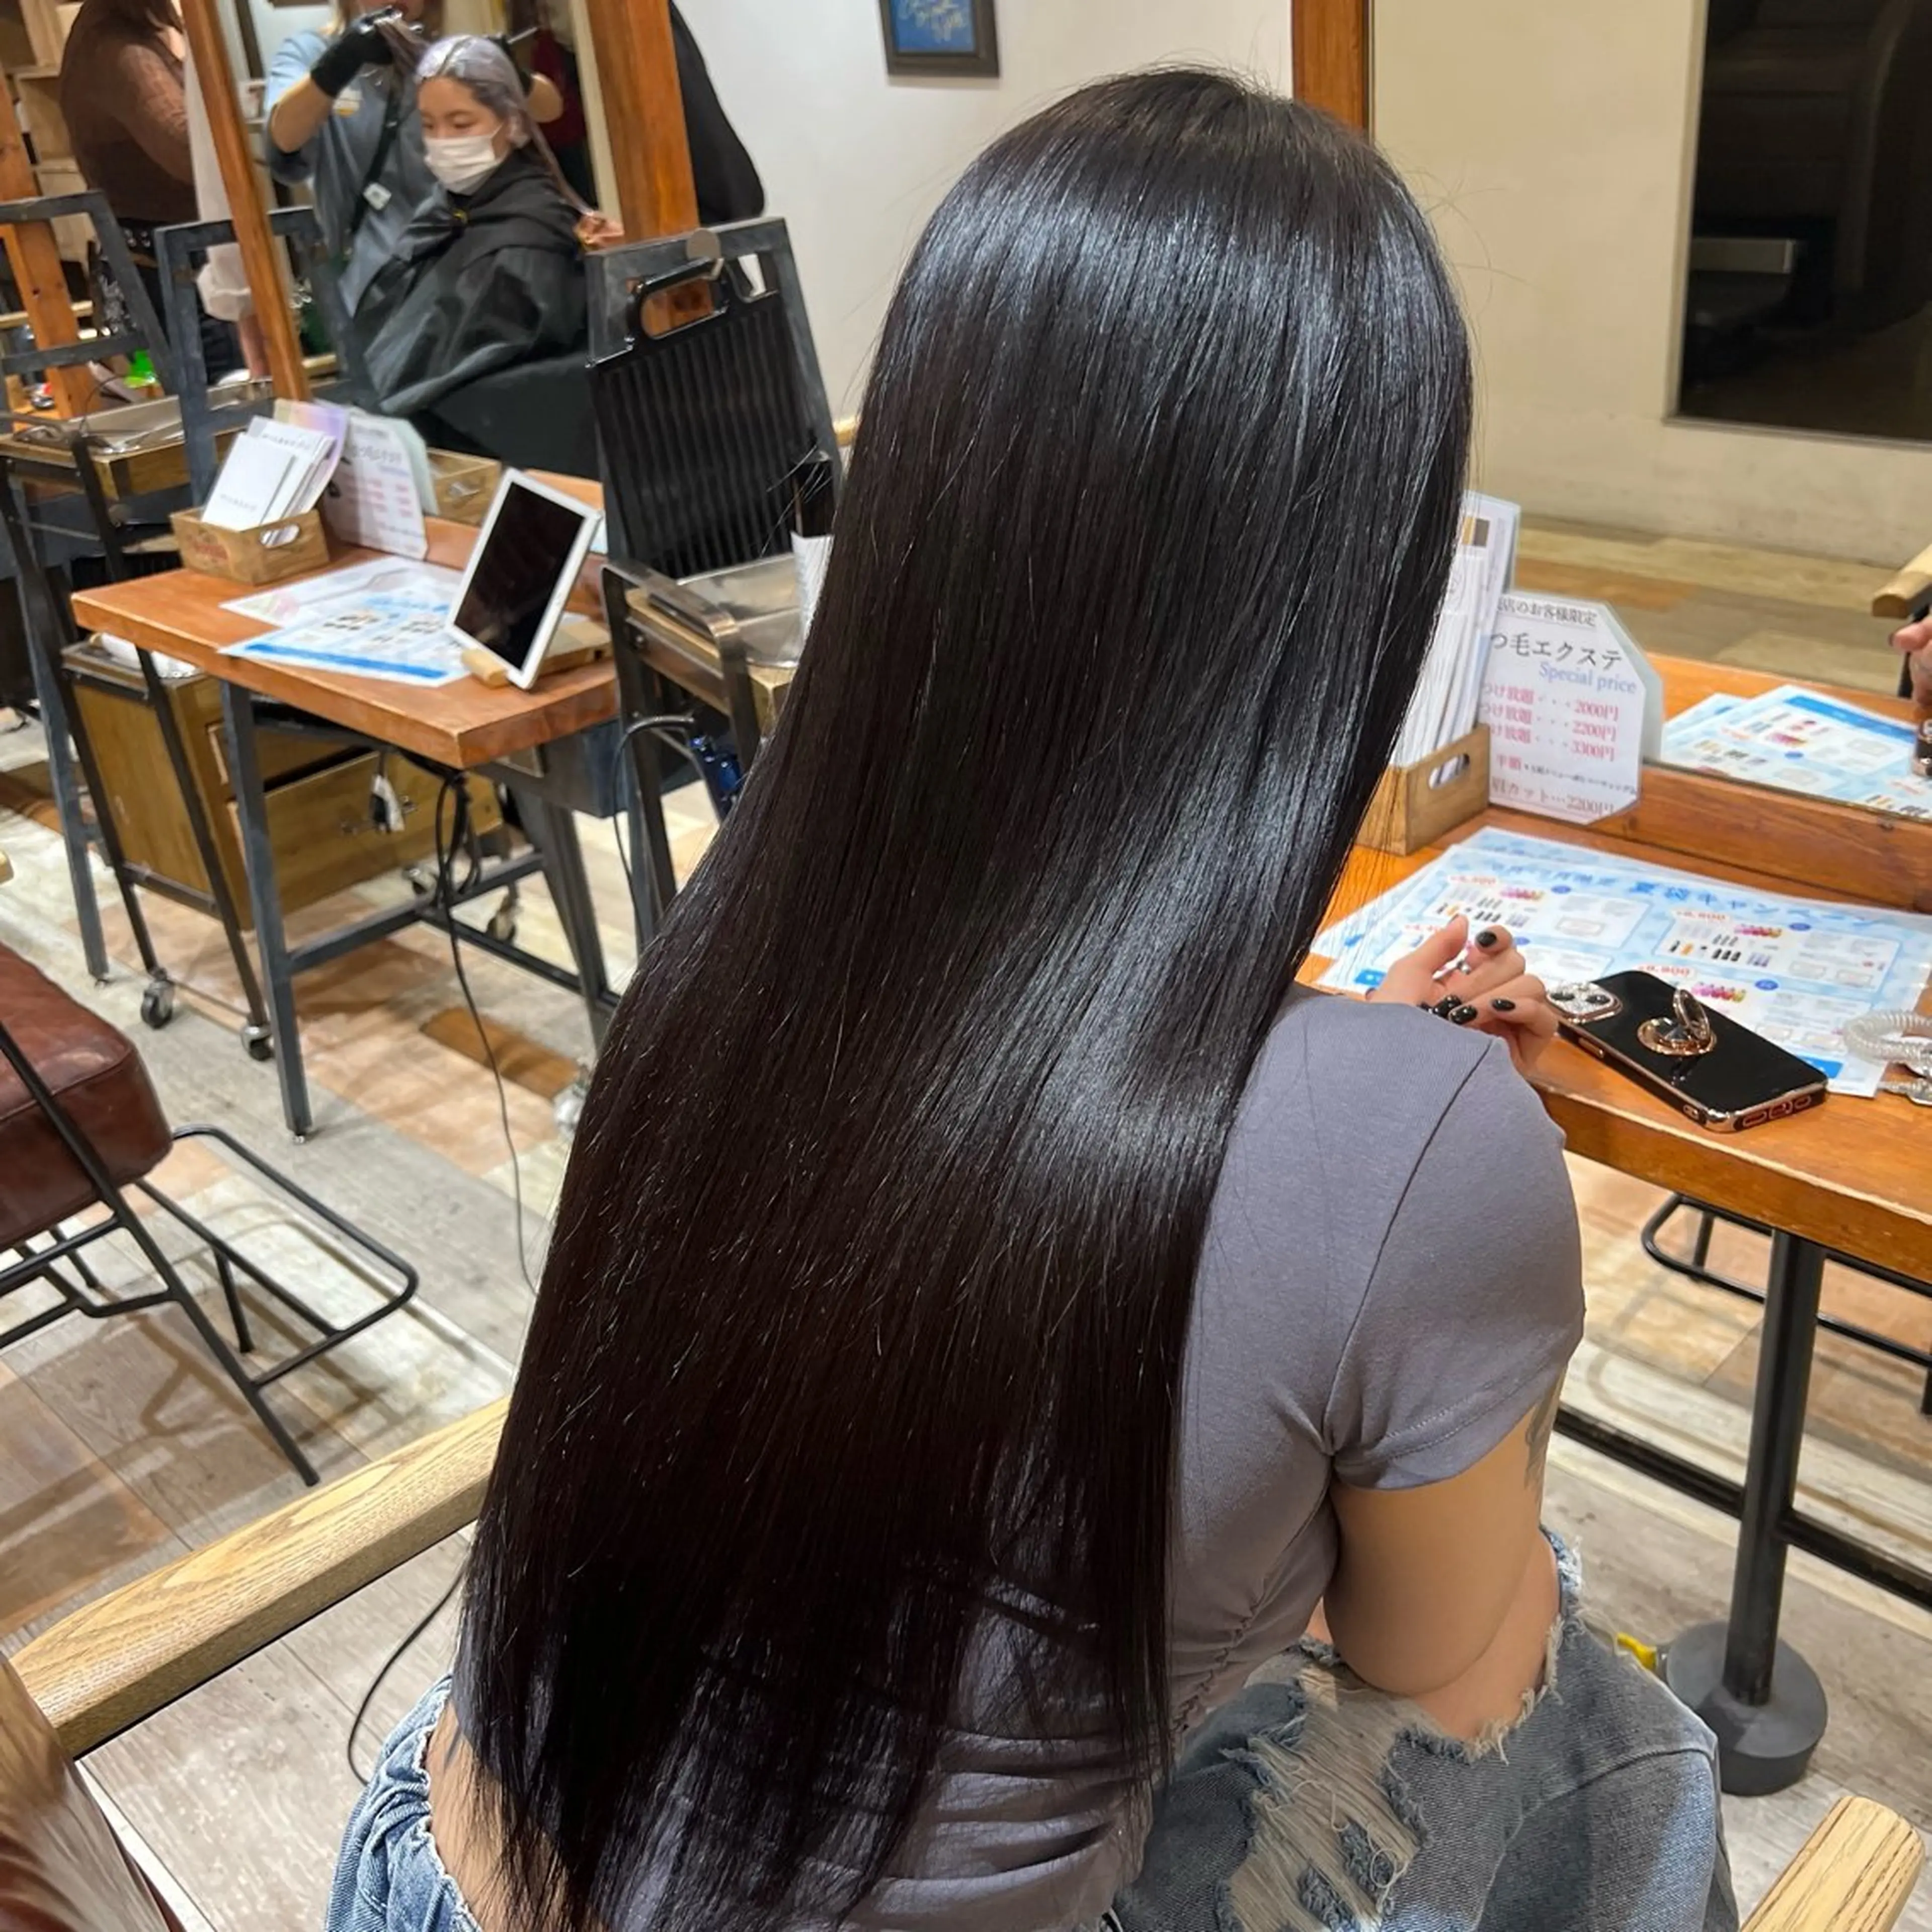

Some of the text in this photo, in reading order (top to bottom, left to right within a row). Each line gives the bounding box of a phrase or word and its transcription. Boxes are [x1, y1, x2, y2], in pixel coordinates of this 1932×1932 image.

[1490, 632, 1622, 670] つ毛エクステ
[1539, 661, 1637, 694] Special price
